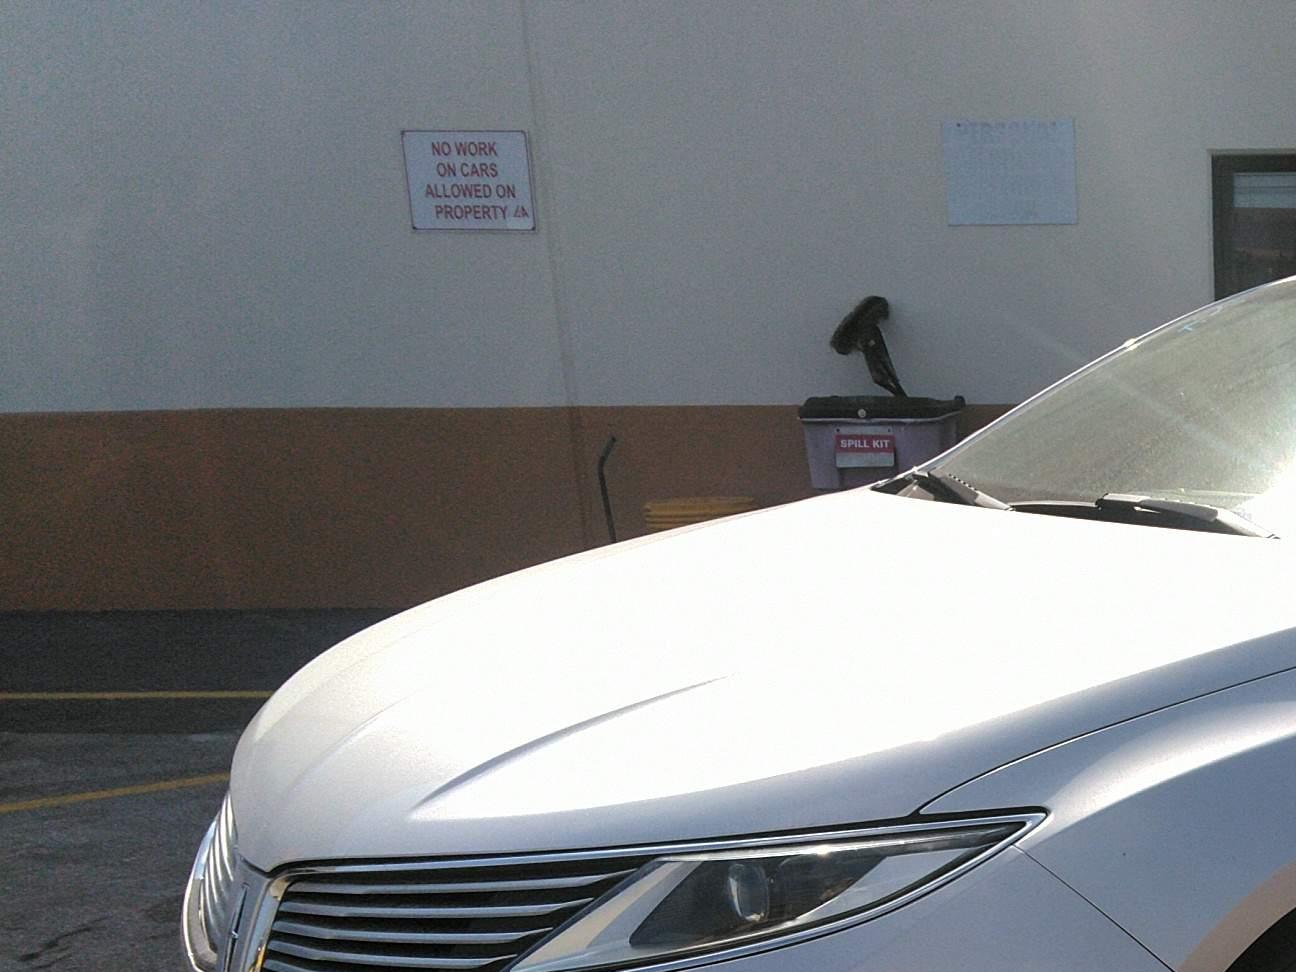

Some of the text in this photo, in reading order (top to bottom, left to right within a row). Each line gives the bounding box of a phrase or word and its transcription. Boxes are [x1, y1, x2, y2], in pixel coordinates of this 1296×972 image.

[431, 141, 498, 156] NO WORK
[436, 162, 498, 178] ON CARS
[425, 183, 516, 199] ALLOWED ON
[434, 204, 508, 220] PROPERTY
[840, 439, 890, 448] SPILL KIT
